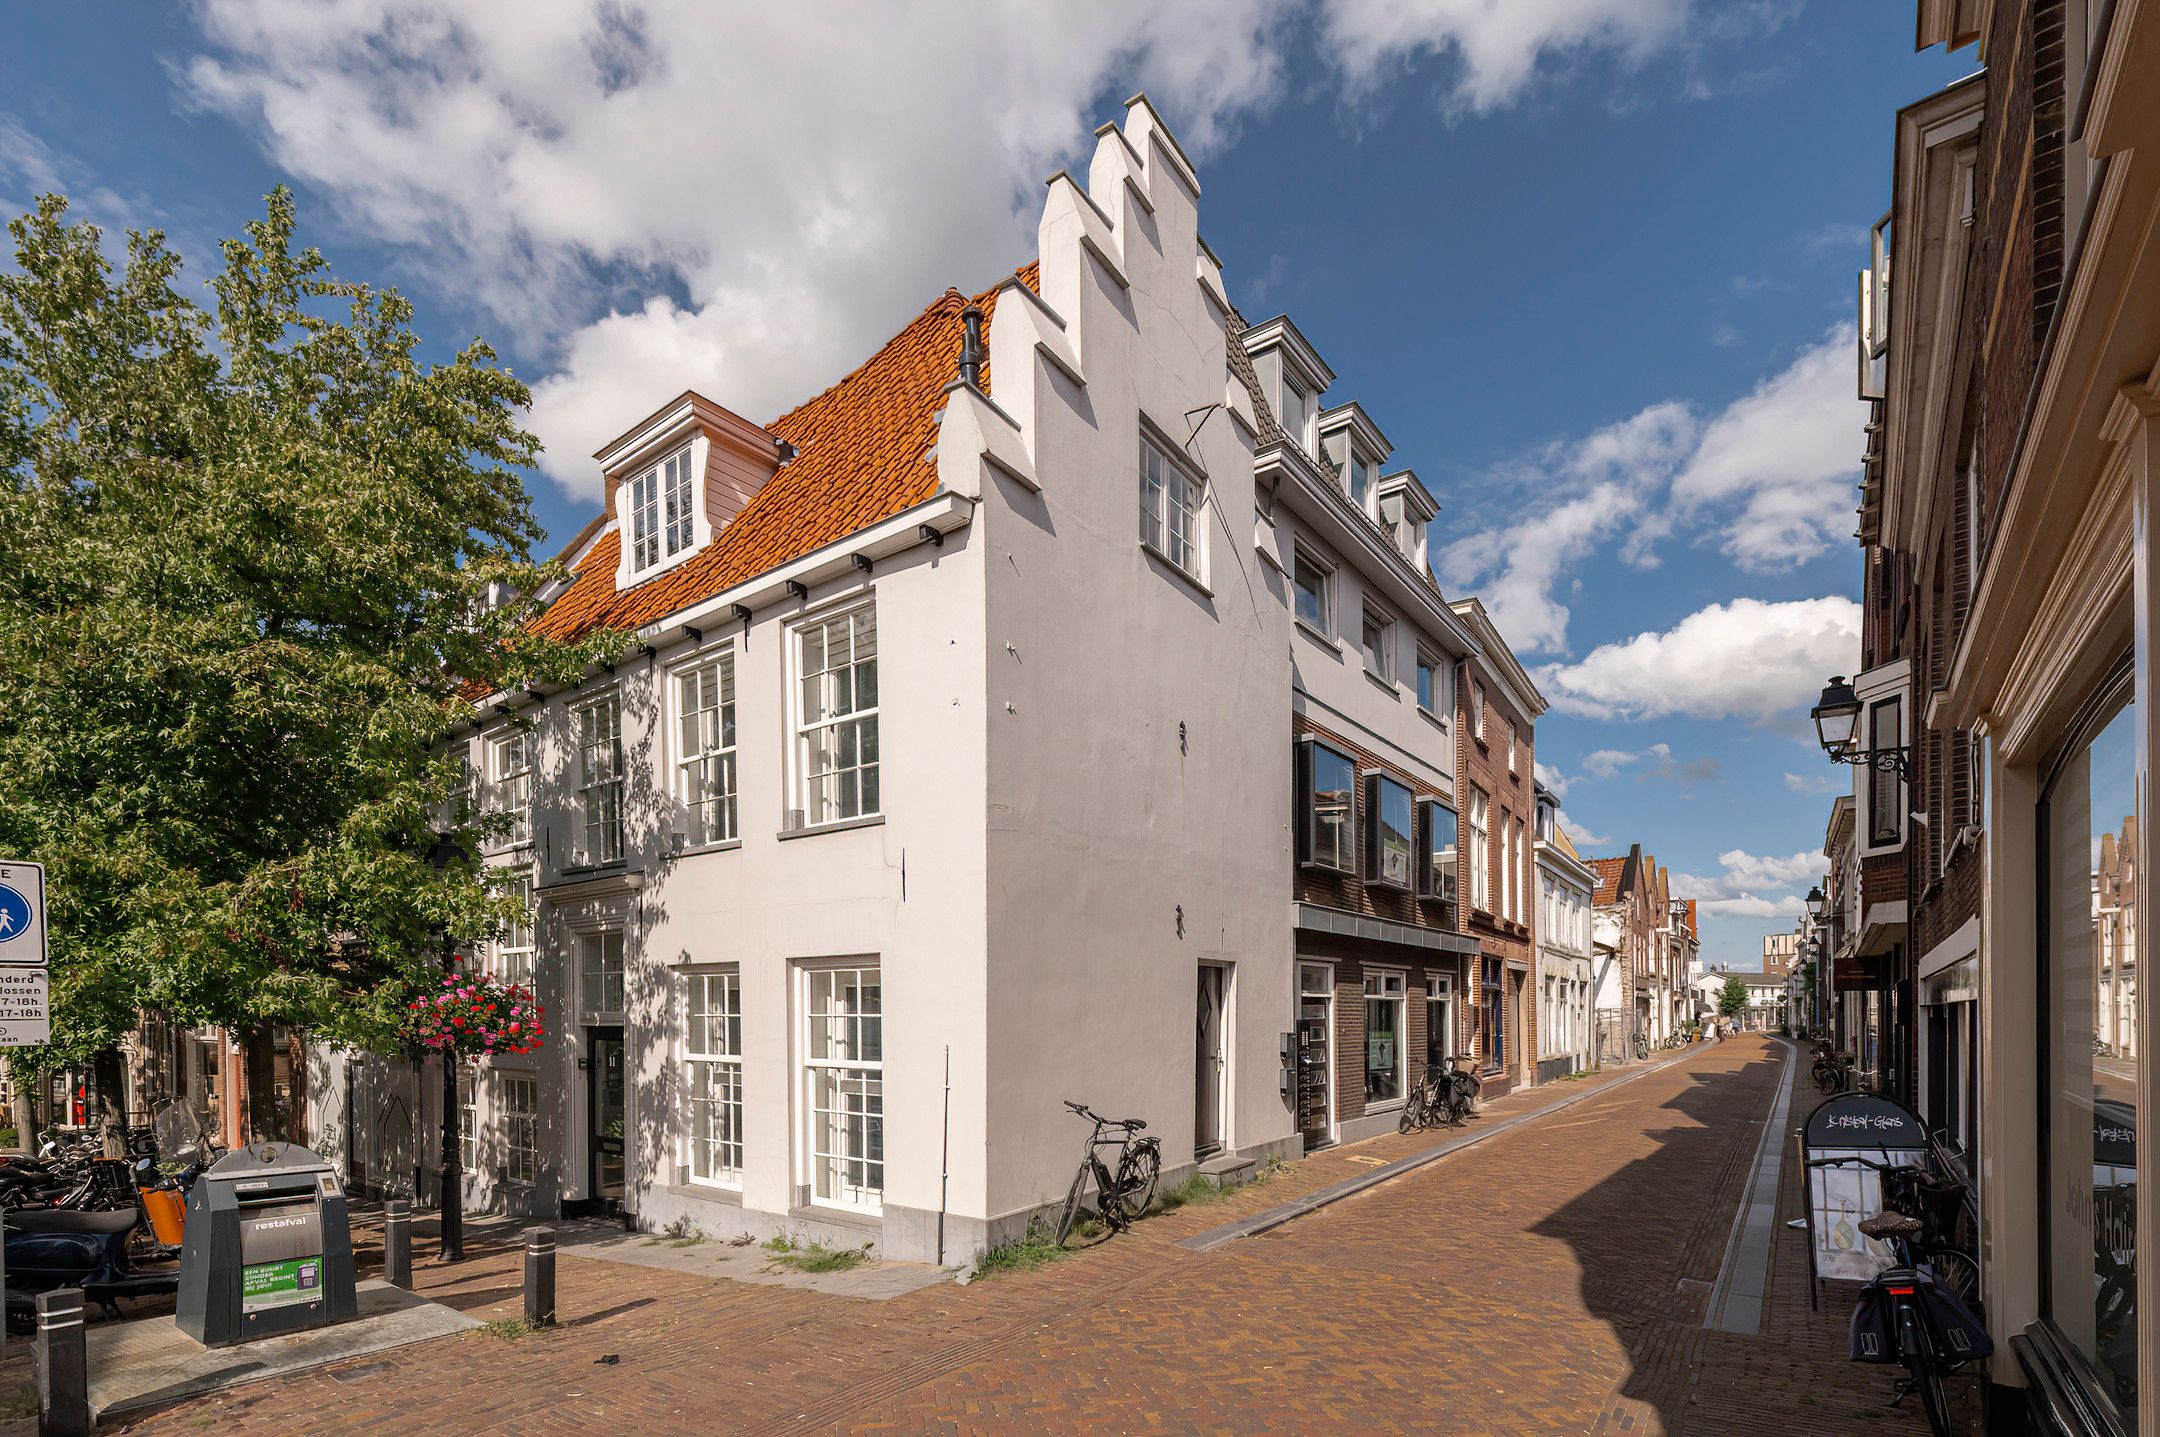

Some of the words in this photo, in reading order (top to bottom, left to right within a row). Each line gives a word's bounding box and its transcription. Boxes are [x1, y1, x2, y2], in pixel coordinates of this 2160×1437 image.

[1, 869, 11, 879] E
[0, 1009, 41, 1017] 17-18h
[255, 1217, 306, 1230] restafval
